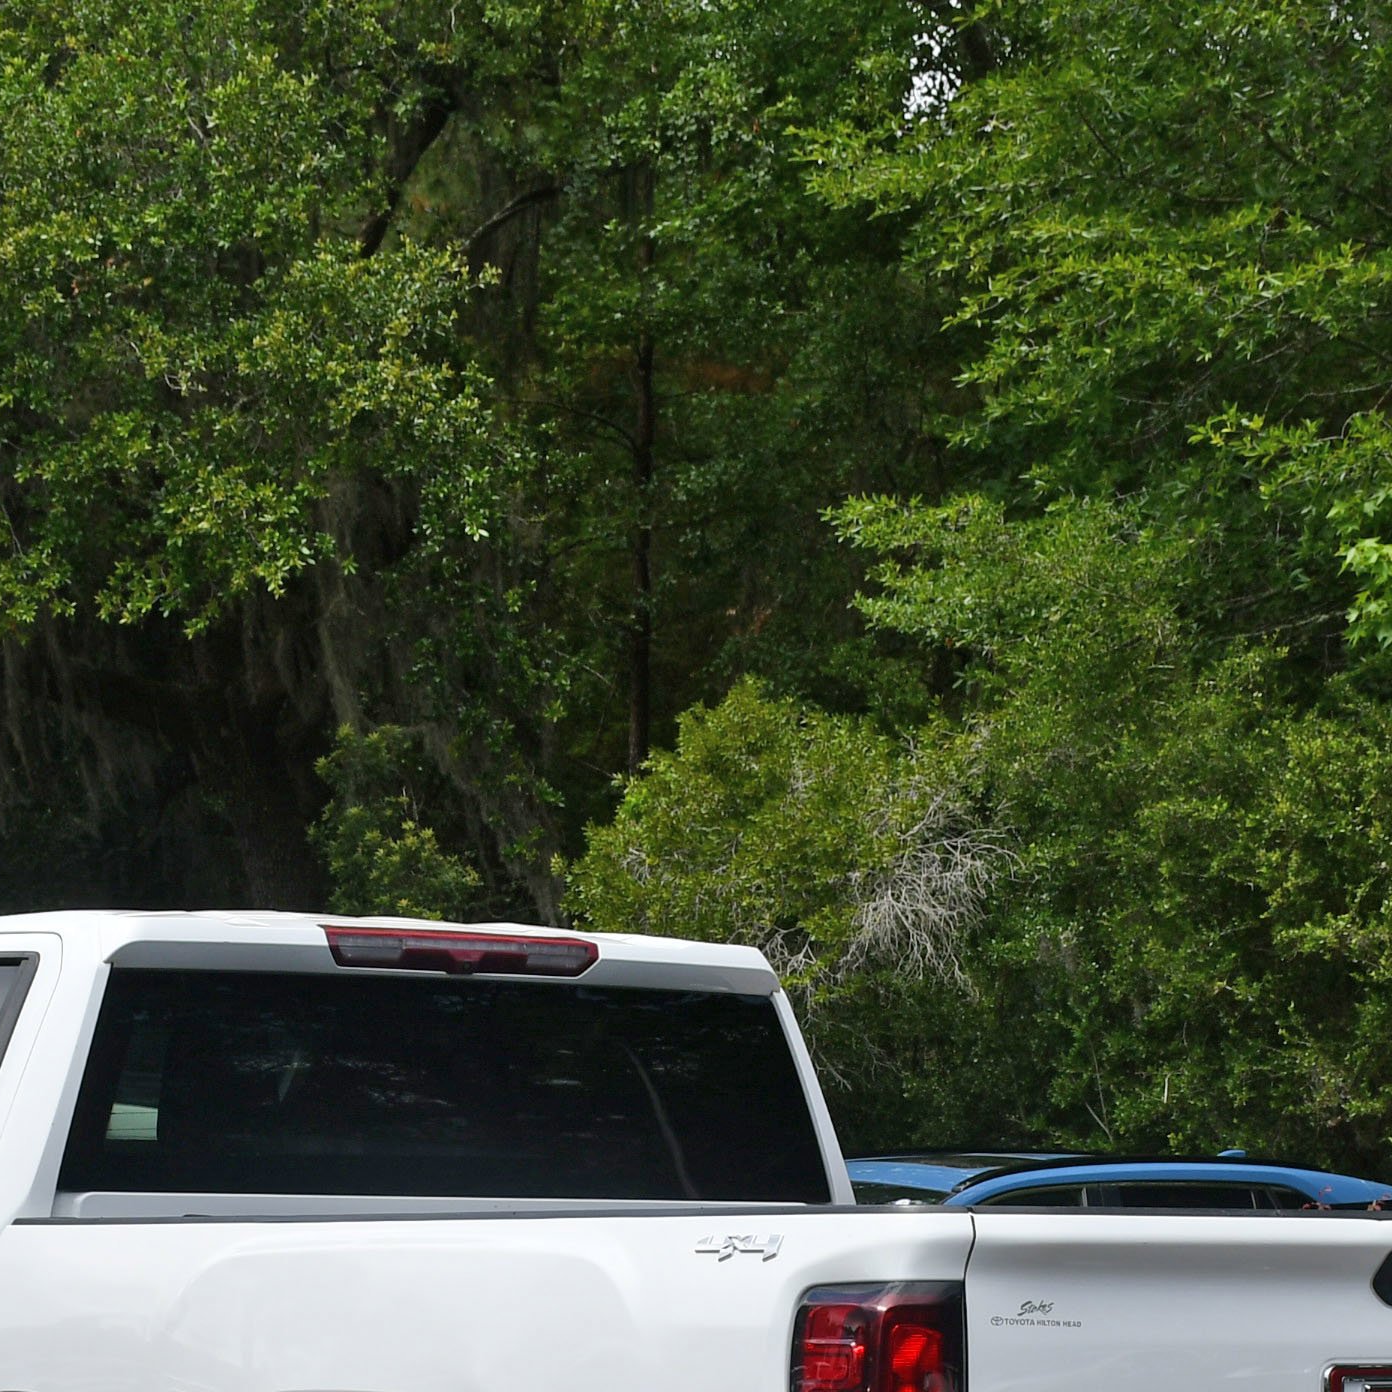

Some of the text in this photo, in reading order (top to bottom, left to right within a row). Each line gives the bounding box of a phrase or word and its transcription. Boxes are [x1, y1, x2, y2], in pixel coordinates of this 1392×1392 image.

[1004, 1318, 1082, 1329] TOYOTA HILTON HEAD
